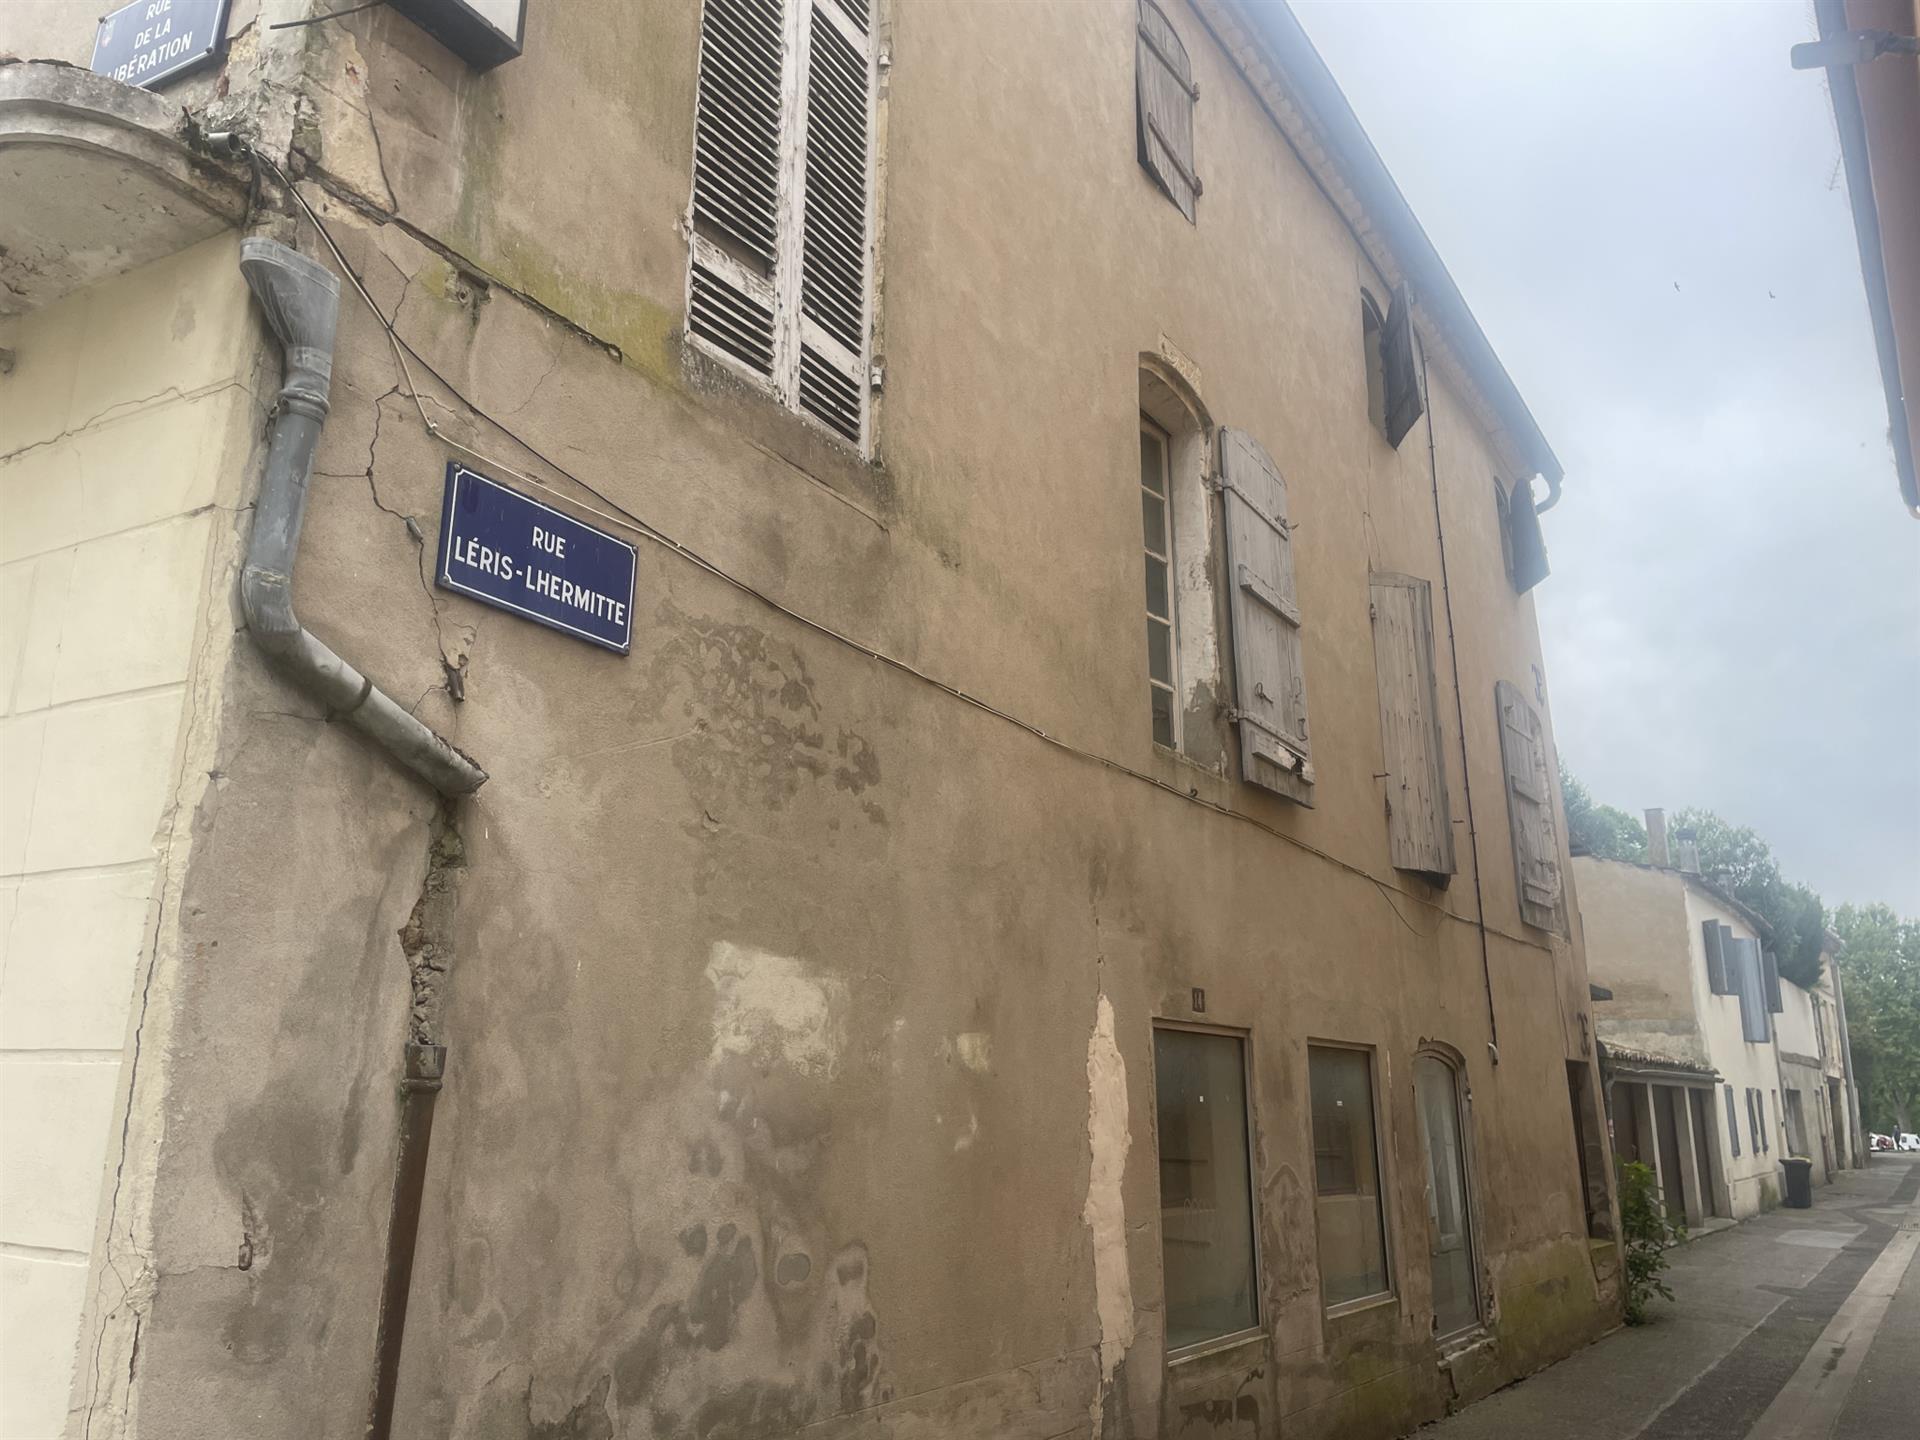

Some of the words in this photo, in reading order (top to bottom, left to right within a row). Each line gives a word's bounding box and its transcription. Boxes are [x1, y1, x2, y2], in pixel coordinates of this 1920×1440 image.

[134, 27, 153, 50] DE
[155, 18, 171, 39] LA
[532, 526, 566, 559] RUE
[454, 536, 626, 626] LÉRIS-LHERMITTE
